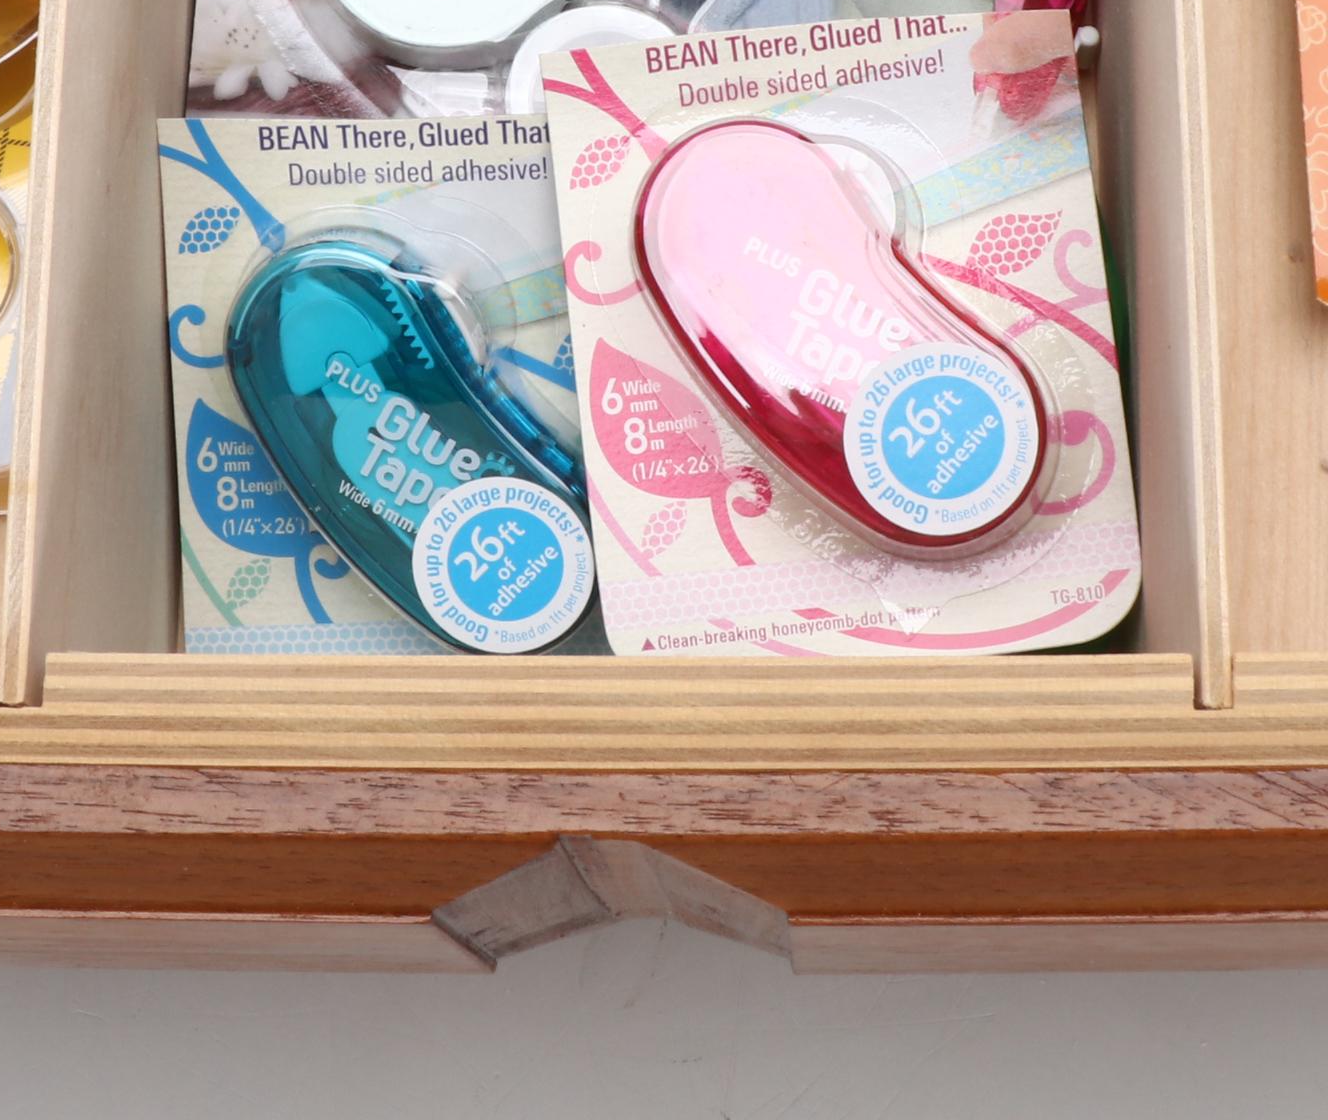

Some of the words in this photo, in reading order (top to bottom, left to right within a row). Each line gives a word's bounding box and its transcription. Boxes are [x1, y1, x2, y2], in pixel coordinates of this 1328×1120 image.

[645, 39, 719, 74] BEAN
[725, 34, 808, 62] There,
[809, 19, 882, 52] Glued
[678, 76, 760, 108] Double
[767, 65, 829, 97] sided
[835, 49, 945, 87] adhesive!
[258, 125, 329, 151] BEAN
[336, 124, 415, 150] There,
[418, 121, 488, 147] Glued
[289, 162, 366, 186] Double
[374, 159, 433, 183] sided
[441, 157, 548, 182] adhesive!
[743, 237, 801, 277] PLUS
[798, 270, 911, 351] Glue
[325, 360, 382, 403] PLUS
[884, 354, 935, 386] large
[601, 378, 623, 415] 6
[622, 380, 661, 395] Wide
[865, 380, 890, 407] 26
[630, 399, 658, 412] mm
[859, 409, 877, 427] to
[376, 397, 480, 480] Glue
[623, 417, 648, 455] 8
[648, 415, 698, 434] Length
[197, 437, 218, 473] 6
[217, 442, 255, 456] Wide
[650, 439, 665, 450] m
[860, 432, 877, 456] up
[927, 414, 999, 495] adhesive
[935, 429, 955, 454] of
[224, 462, 250, 472] mm
[865, 462, 885, 490] for
[216, 476, 239, 511] 8
[240, 478, 288, 496] Length
[339, 480, 370, 508] Wide
[453, 487, 501, 514] large
[241, 498, 254, 509] m
[878, 485, 928, 524] Good
[433, 507, 458, 533] 26
[426, 533, 444, 551] to
[427, 553, 443, 577] up
[497, 557, 517, 580] of
[430, 580, 450, 607] for
[488, 545, 560, 617] adhesive
[1051, 585, 1104, 605] TG-810
[443, 605, 489, 643] Good
[537, 621, 551, 635] on
[550, 608, 565, 624] 1ft
[564, 593, 577, 613] per
[657, 625, 767, 651] Clean-breaking
[771, 610, 884, 638] honeycomb-dot
